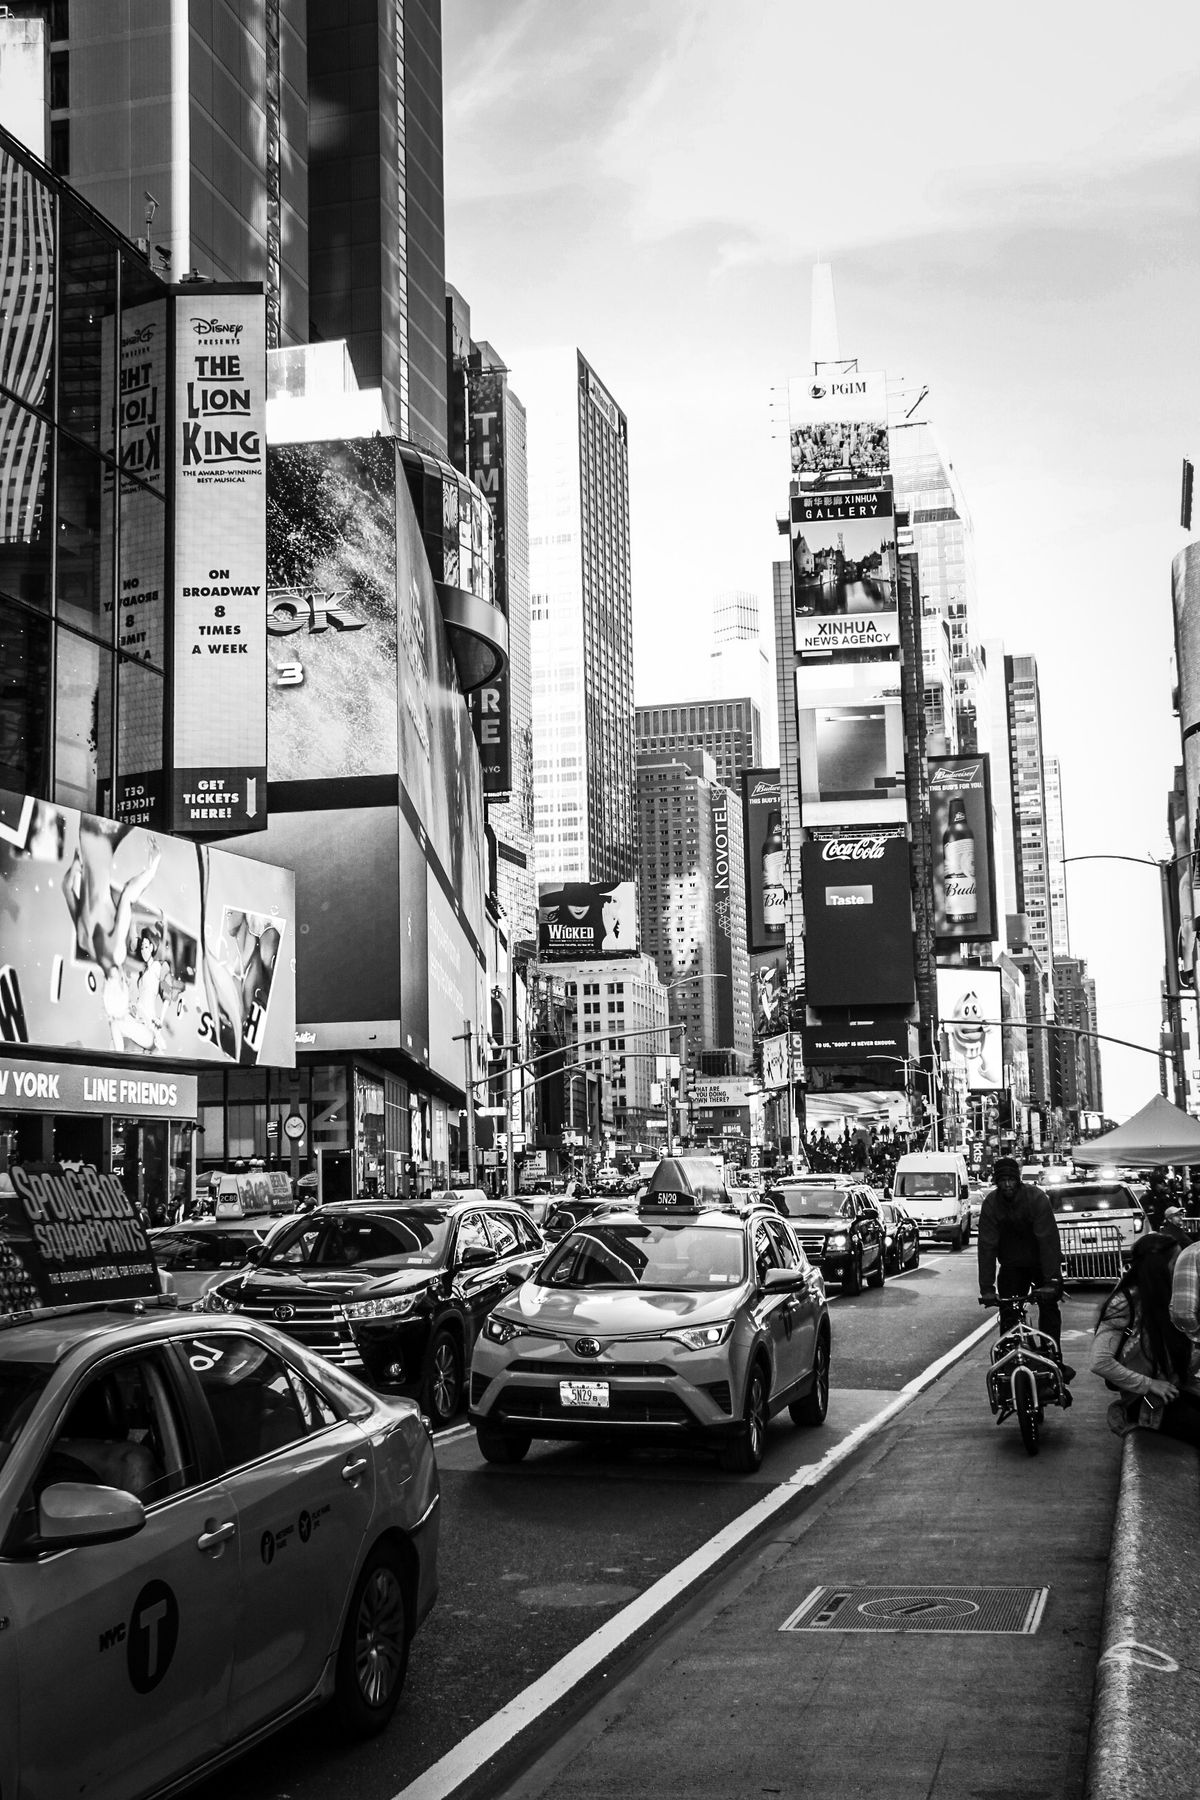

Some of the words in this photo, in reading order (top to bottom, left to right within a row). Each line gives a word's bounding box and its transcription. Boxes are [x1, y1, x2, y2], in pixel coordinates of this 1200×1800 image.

[190, 318, 243, 338] Disney
[194, 355, 241, 377] THE
[832, 382, 867, 395] PGIM
[187, 382, 251, 418] LION
[182, 422, 260, 465] KING
[198, 469, 262, 477] AWARD-WINNING
[845, 494, 878, 504] XINHUA
[805, 505, 878, 519] GALLERY
[208, 569, 230, 579] ON
[182, 586, 261, 597] BROADWAY
[214, 605, 226, 617] 8
[199, 625, 242, 635] TIMES
[817, 621, 877, 635] XINHUA
[805, 636, 839, 646] NEWS
[842, 633, 891, 645] AGENCY
[191, 645, 202, 654] A
[208, 644, 248, 654] WEEK
[198, 780, 225, 791] GET
[183, 793, 240, 804] TICKETS
[190, 808, 232, 819] HERE!
[830, 895, 865, 905] Taste
[13, 1072, 60, 1099] YORK
[84, 1077, 117, 1103] LINE
[119, 1079, 178, 1107] FRIENDS
[11, 1165, 134, 1222] SPONGEBOB
[657, 1193, 677, 1204] 5N29
[34, 1218, 147, 1262] SQUAREPANTS
